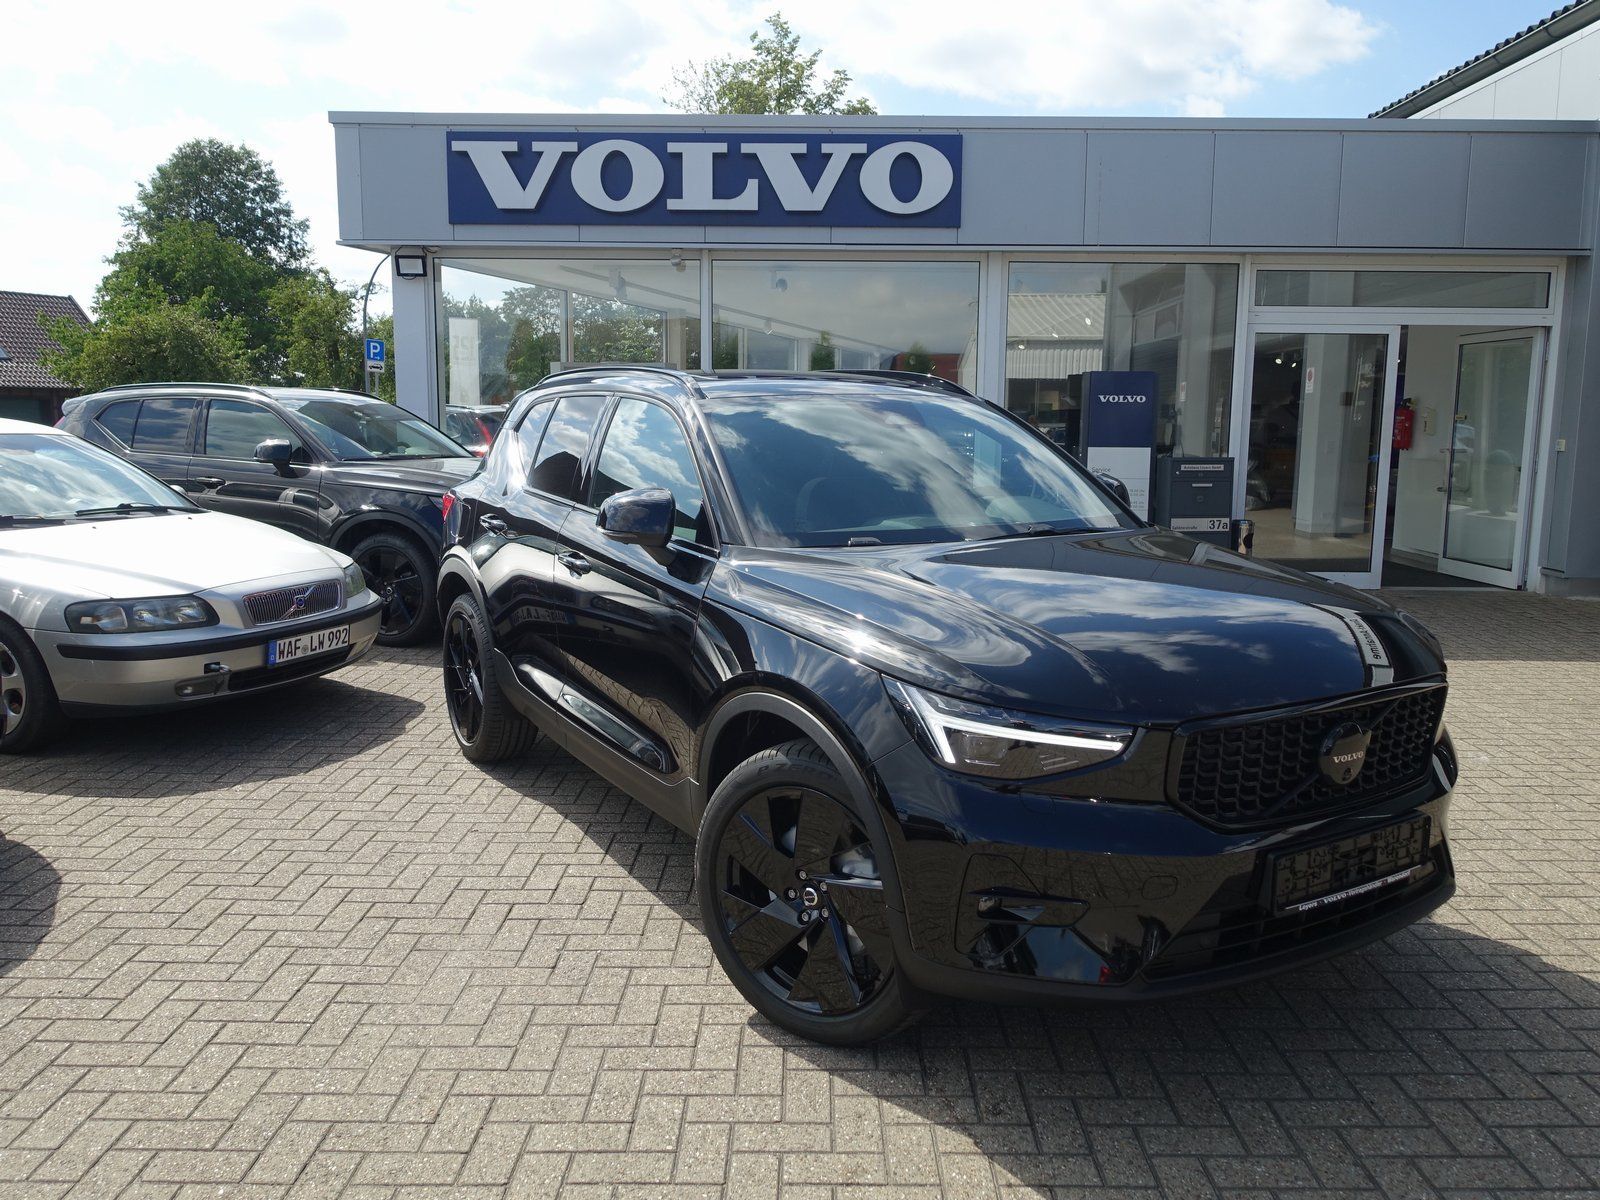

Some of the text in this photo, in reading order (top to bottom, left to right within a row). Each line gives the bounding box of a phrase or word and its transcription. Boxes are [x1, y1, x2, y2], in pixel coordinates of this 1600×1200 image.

[451, 139, 955, 214] VOLVO
[370, 343, 380, 358] P
[1098, 394, 1146, 403] VOLVO
[1209, 520, 1228, 530] 37a
[278, 628, 348, 660] WAF LW 992
[1332, 751, 1364, 763] VOLVO
